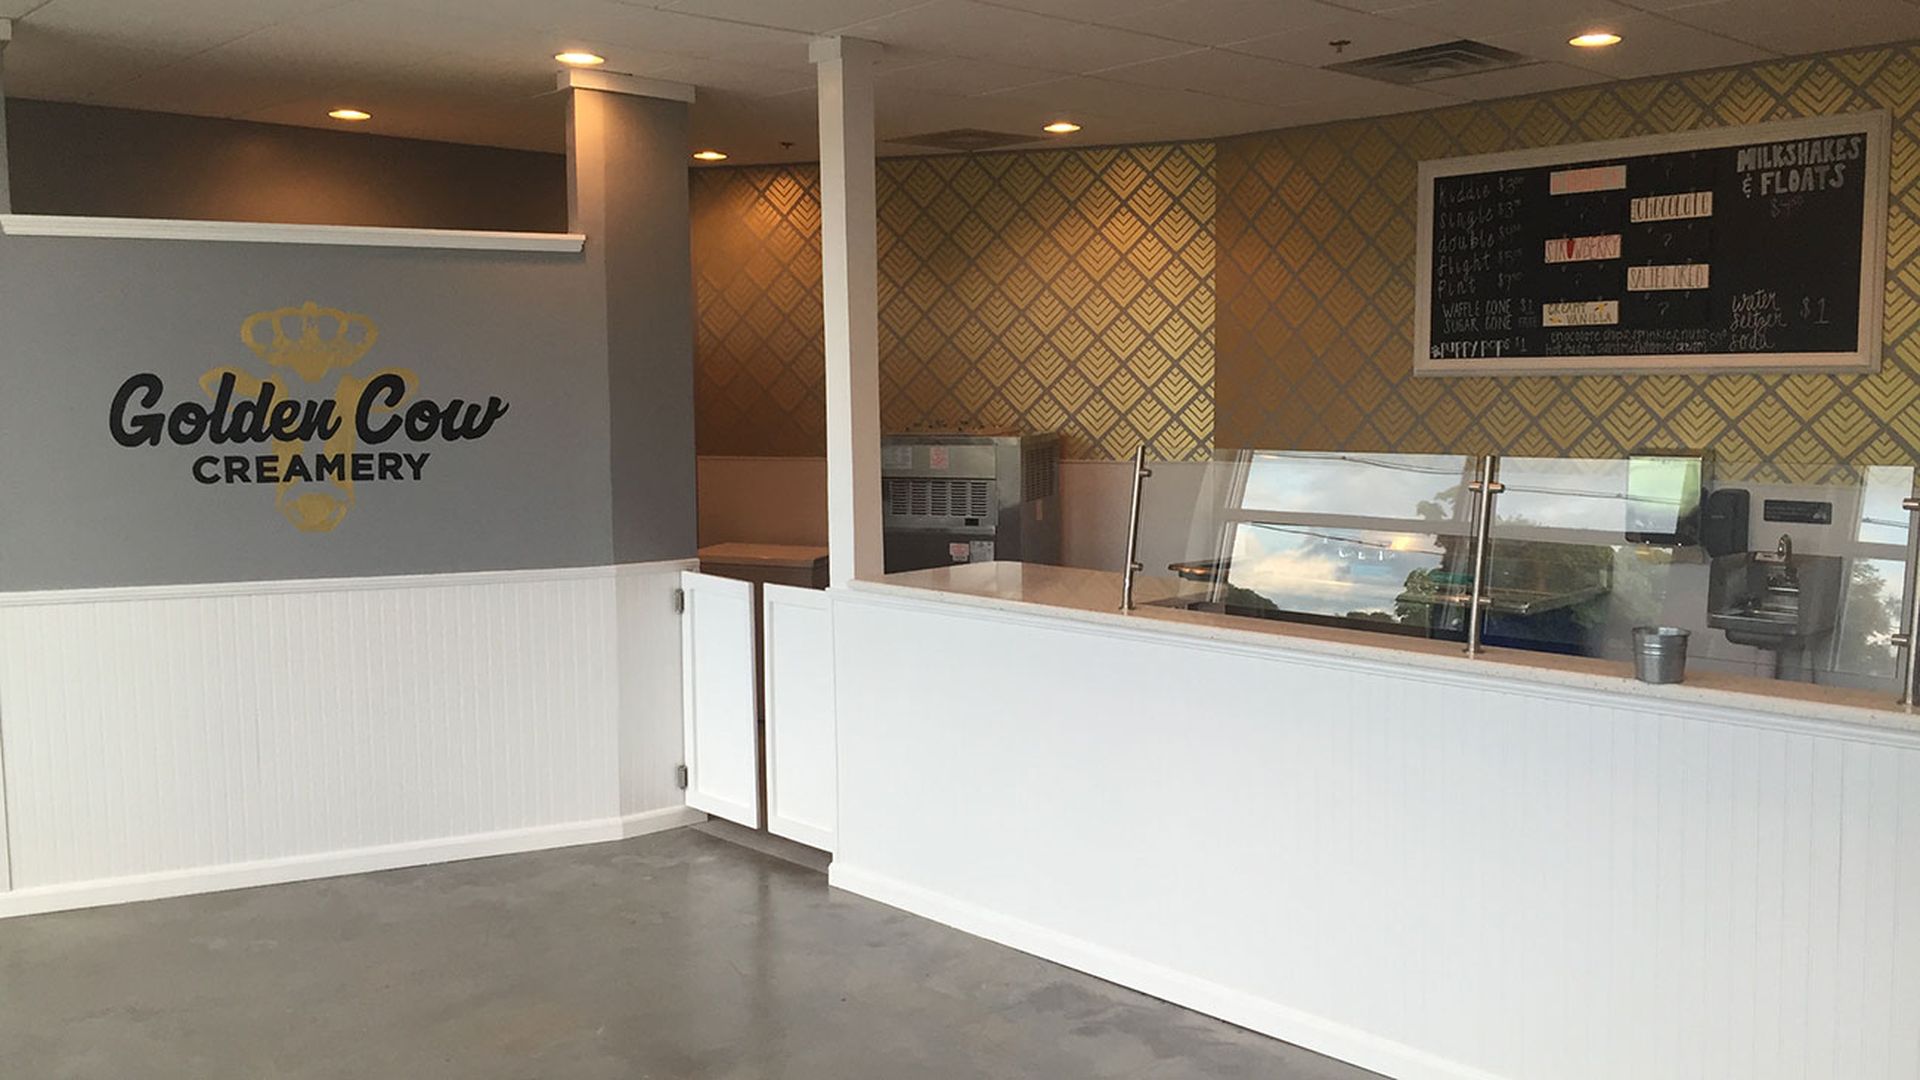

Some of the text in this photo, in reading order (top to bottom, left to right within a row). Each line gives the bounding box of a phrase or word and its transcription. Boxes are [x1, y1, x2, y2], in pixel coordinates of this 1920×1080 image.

[1737, 136, 1861, 173] MILKSHAKES
[1761, 163, 1846, 196] FLOATS
[1438, 229, 1495, 253] double
[1442, 300, 1480, 318] WAFFLE
[109, 372, 510, 447] Golden Cow
[193, 452, 431, 485] CREAMERY
